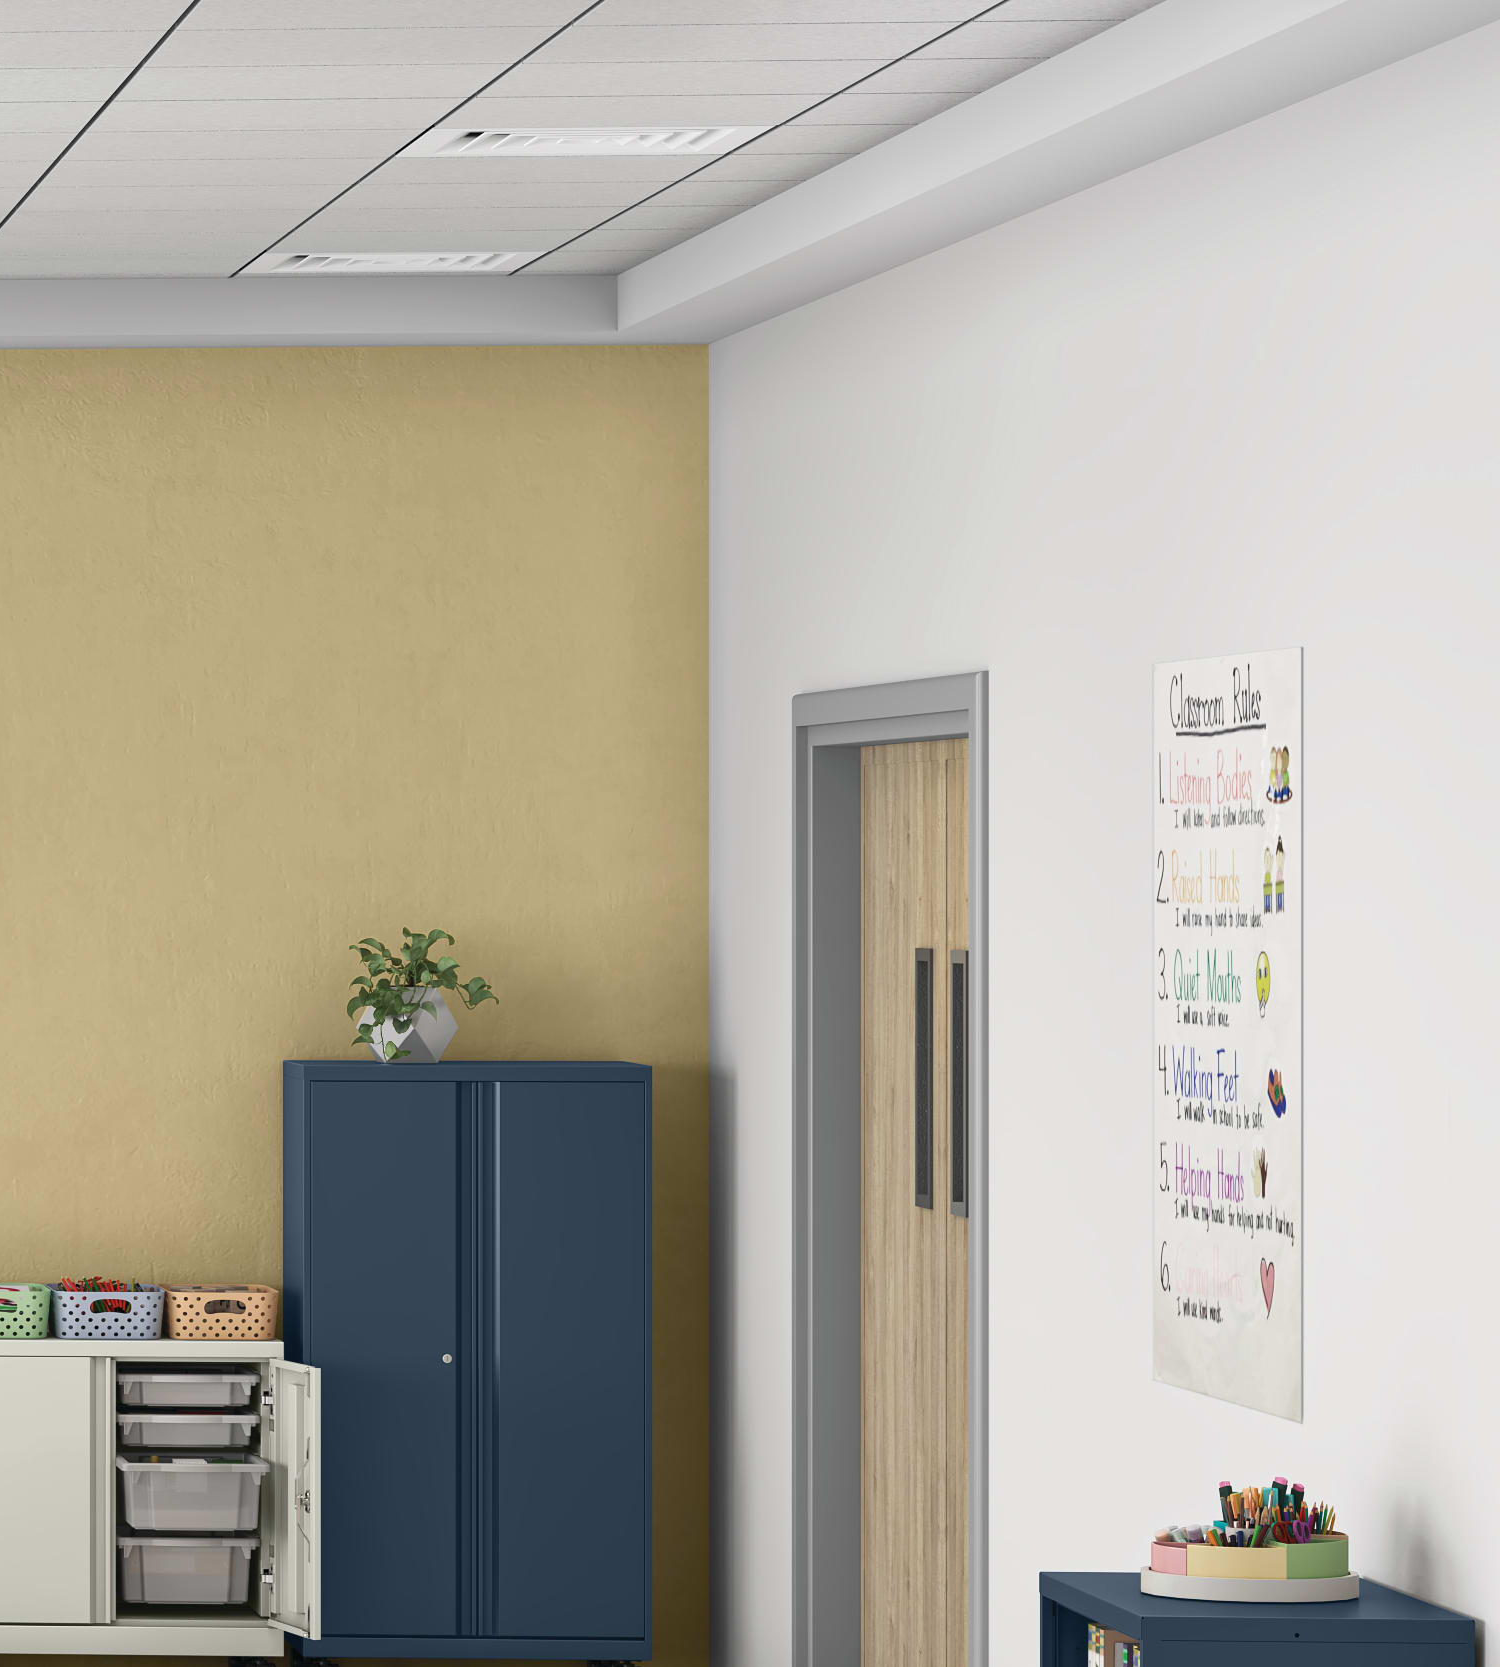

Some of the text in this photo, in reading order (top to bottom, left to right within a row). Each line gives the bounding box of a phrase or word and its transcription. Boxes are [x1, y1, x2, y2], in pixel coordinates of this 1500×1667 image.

[1169, 663, 1262, 729] Classroom Rules
[1217, 746, 1252, 805] Bodies
[1173, 948, 1201, 1001] Quiet
[1172, 1044, 1213, 1118] Walking
[1216, 1048, 1240, 1103] Feet
[1175, 1141, 1212, 1217] Helping
[1217, 1147, 1245, 1204] Hands
